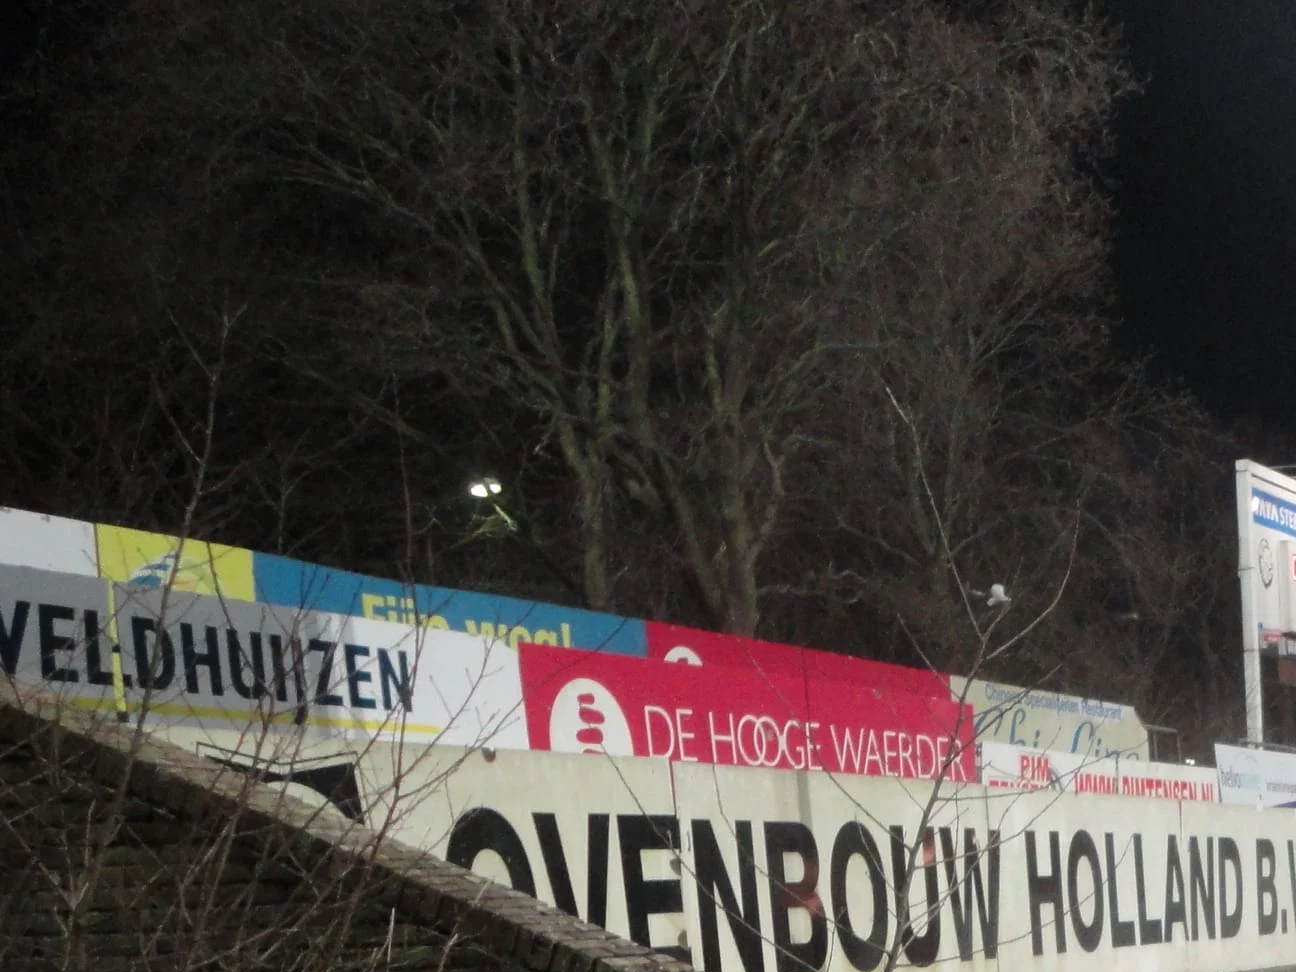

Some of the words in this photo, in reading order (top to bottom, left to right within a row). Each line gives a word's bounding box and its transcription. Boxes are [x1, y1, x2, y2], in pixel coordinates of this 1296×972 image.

[0, 600, 413, 713] VELDHUIZEN
[643, 705, 695, 760] DE
[711, 710, 822, 770] HOOGE
[830, 724, 967, 782] WAERDER
[1020, 754, 1050, 782] PIM
[1070, 720, 1140, 760] Li
[1025, 829, 1243, 956] HOLLAND
